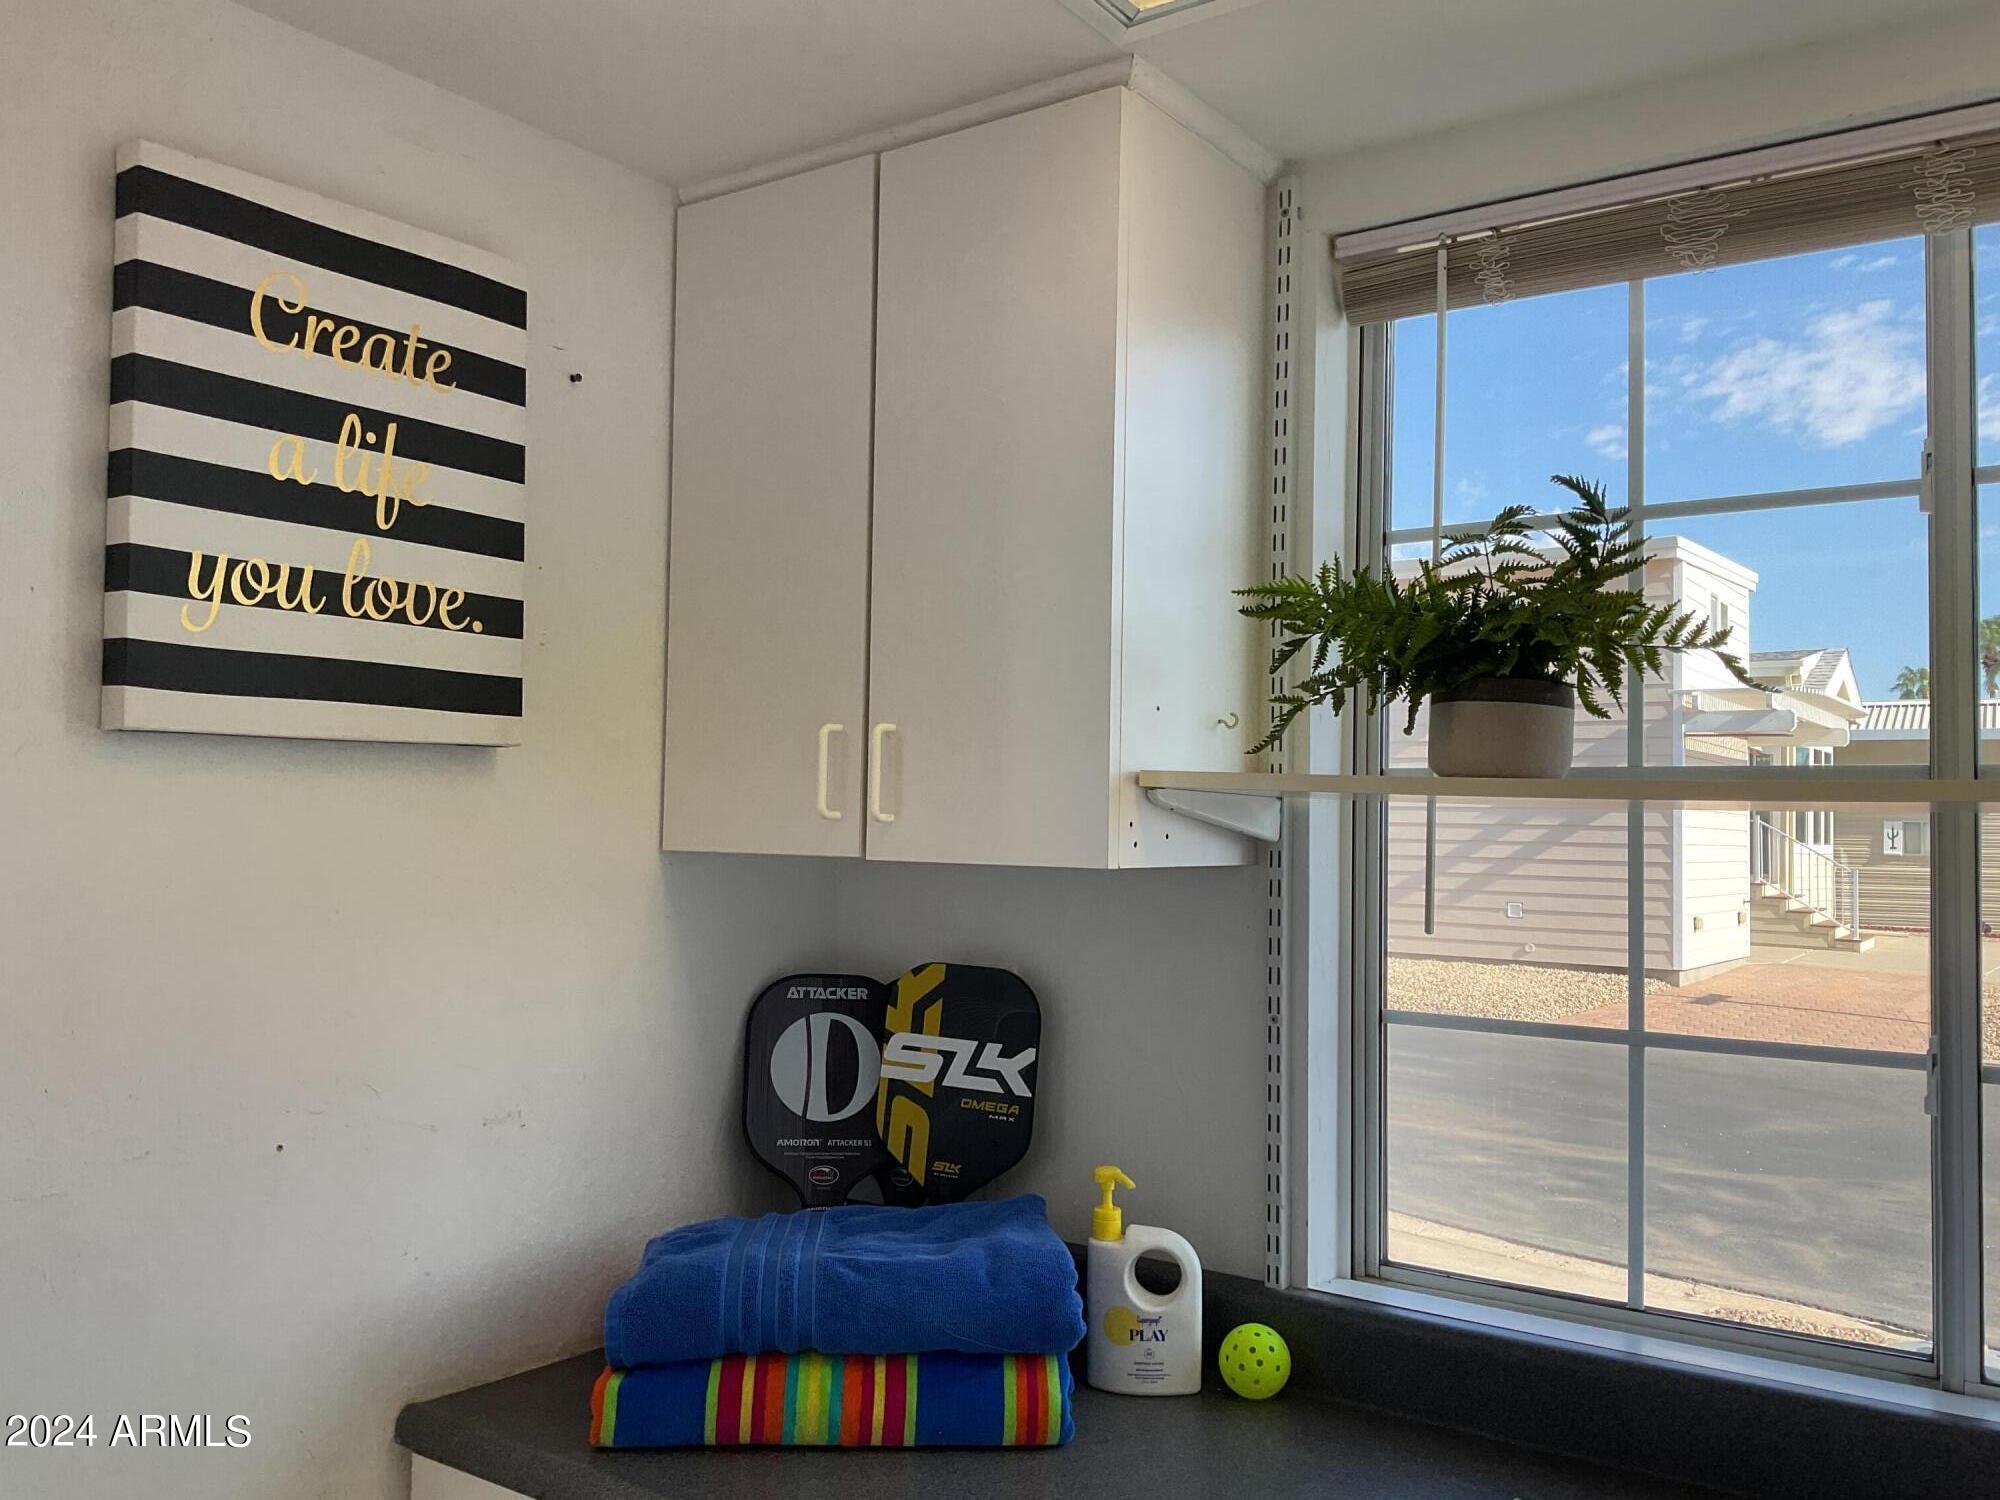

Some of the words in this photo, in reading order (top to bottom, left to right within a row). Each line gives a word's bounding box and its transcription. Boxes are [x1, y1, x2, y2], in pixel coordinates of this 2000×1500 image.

[250, 271, 457, 393] Create
[269, 434, 318, 485] a
[334, 413, 433, 530] life
[181, 549, 327, 633] you
[341, 538, 484, 633] love.
[786, 986, 868, 1000] ATTACKER
[880, 1032, 1037, 1098] SLK
[960, 1098, 1020, 1115] OMEGA
[931, 1161, 962, 1175] SLK
[1129, 1329, 1169, 1342] PLAY
